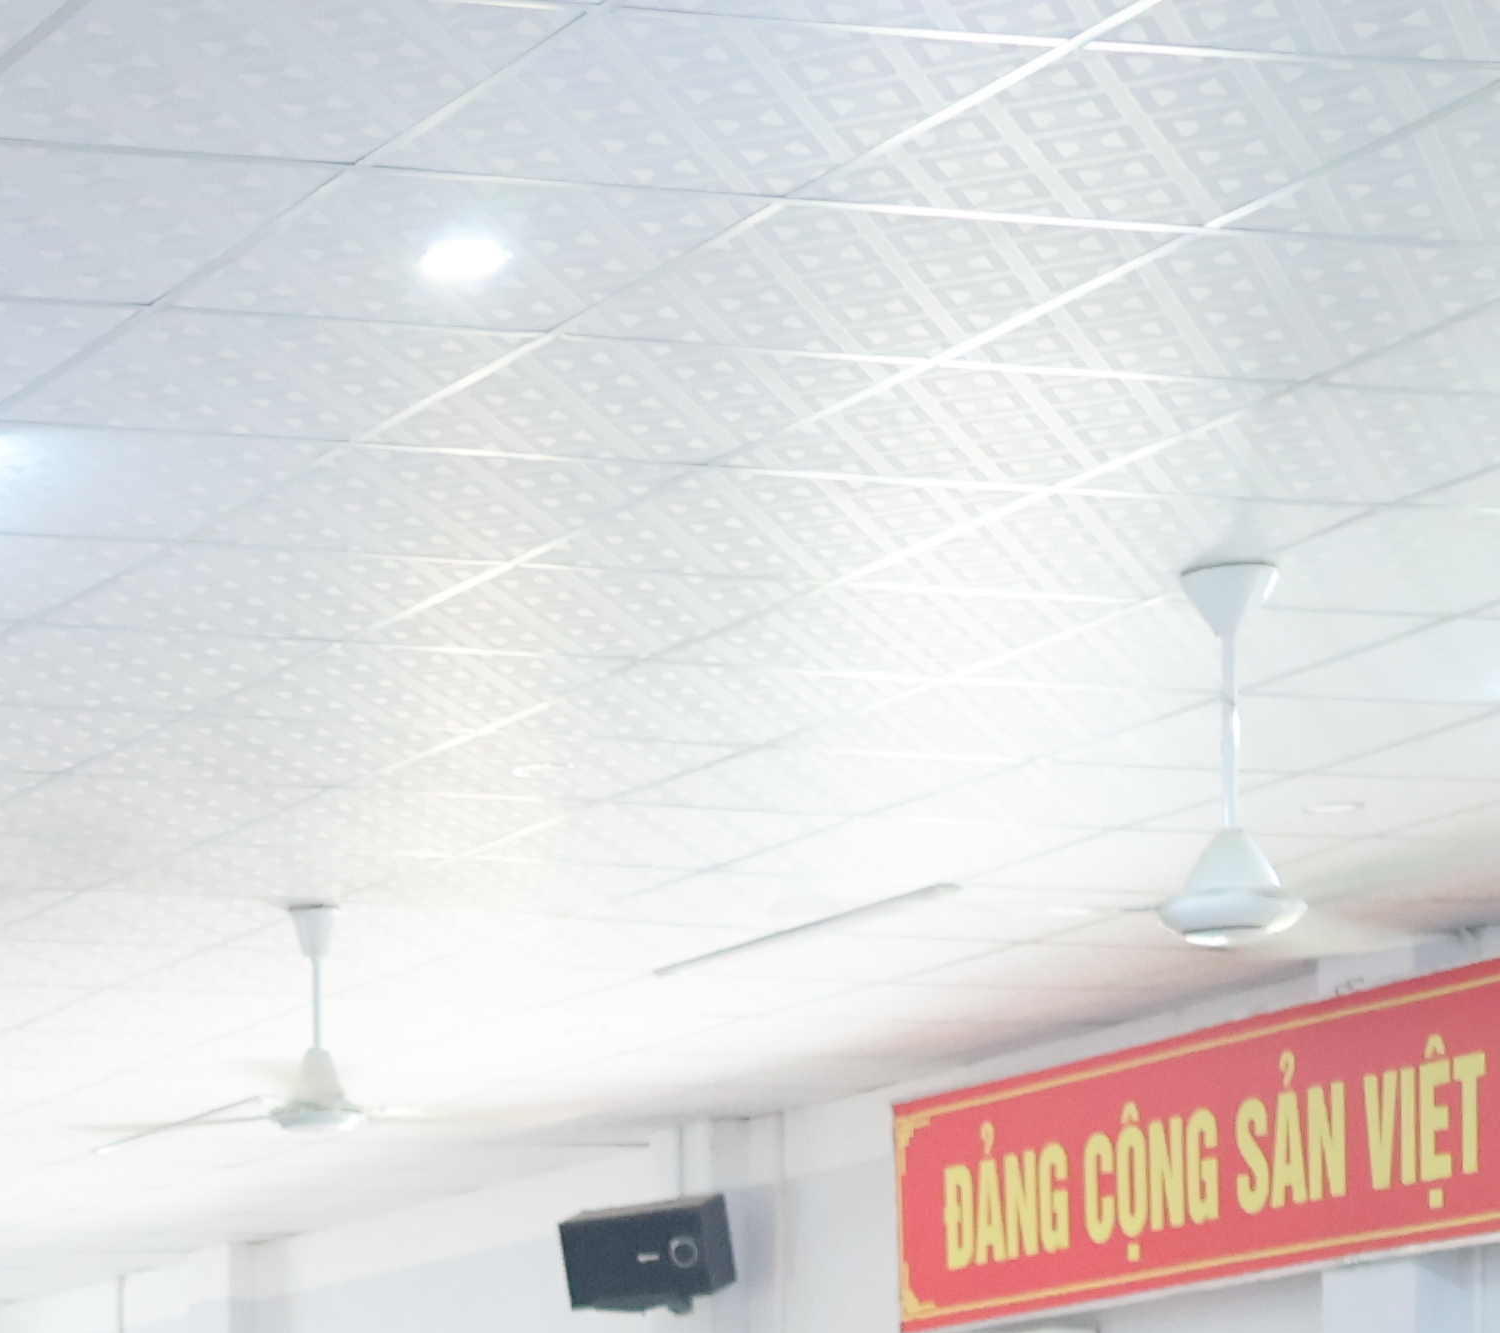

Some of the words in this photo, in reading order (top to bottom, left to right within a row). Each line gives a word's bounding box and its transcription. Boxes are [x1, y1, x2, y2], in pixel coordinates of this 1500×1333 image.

[943, 1120, 1071, 1271] ĐẢNG
[1083, 1100, 1221, 1262] CỘNG
[1236, 1049, 1347, 1215] SẢN
[1363, 1033, 1487, 1209] VIỆT
